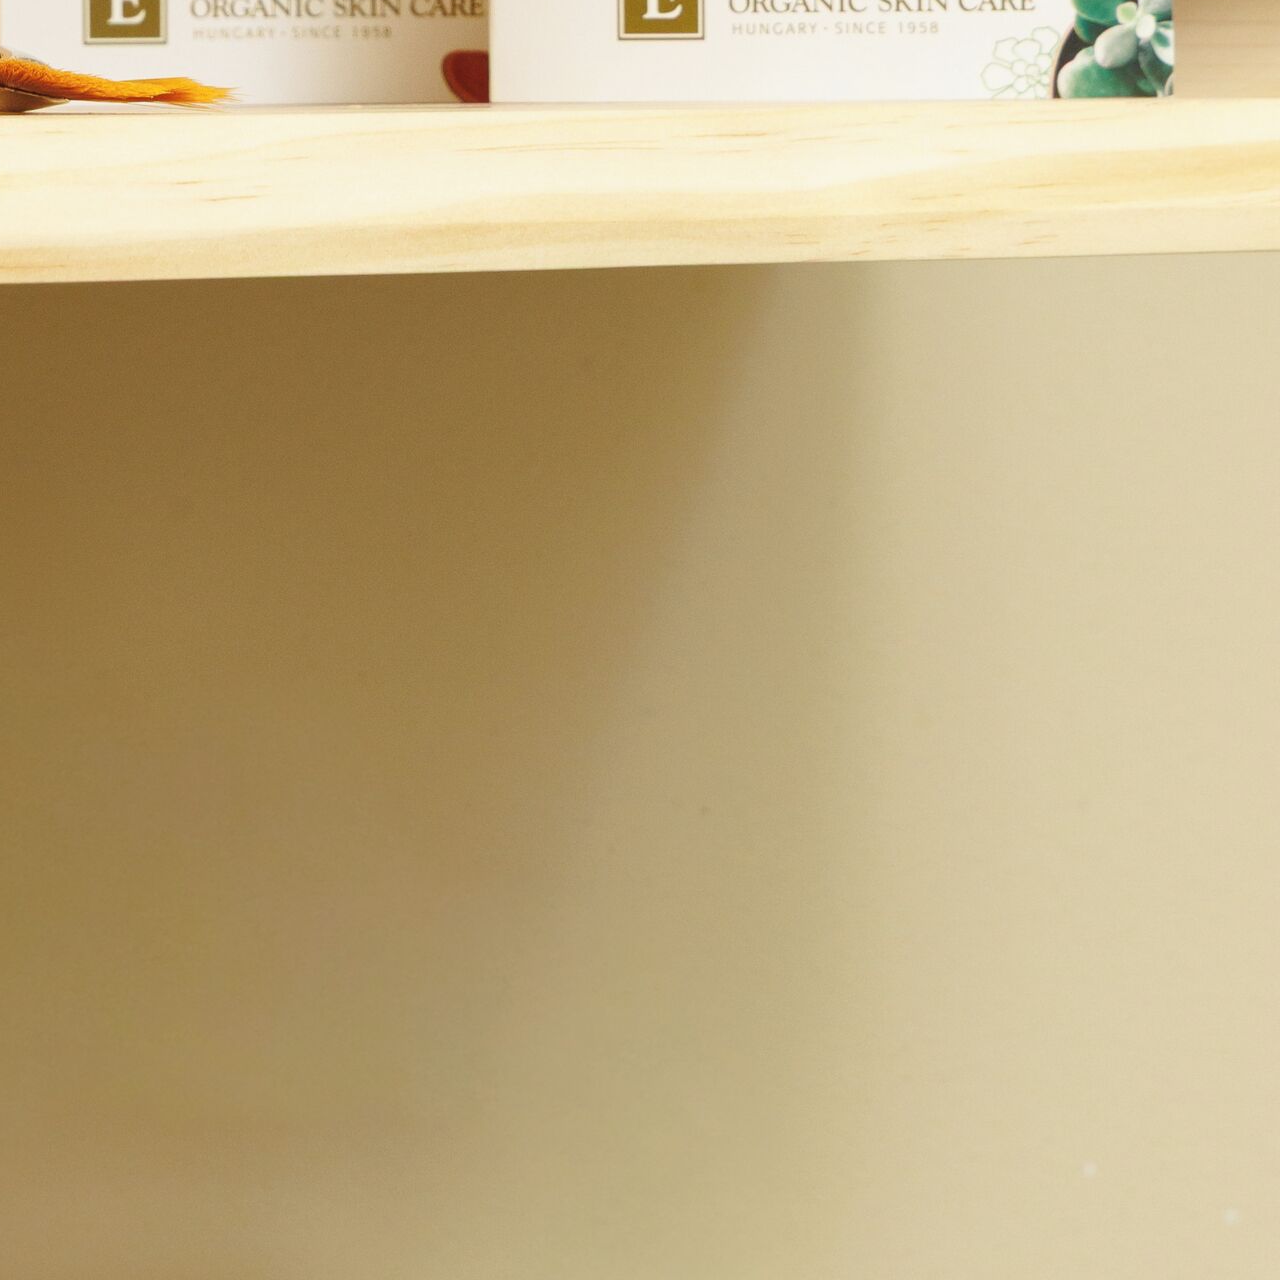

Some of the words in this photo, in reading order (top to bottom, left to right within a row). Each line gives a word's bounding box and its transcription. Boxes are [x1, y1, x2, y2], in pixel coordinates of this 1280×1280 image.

[731, 21, 818, 36] HUNGARY
[834, 20, 887, 35] SINCE
[897, 20, 940, 35] 1958
